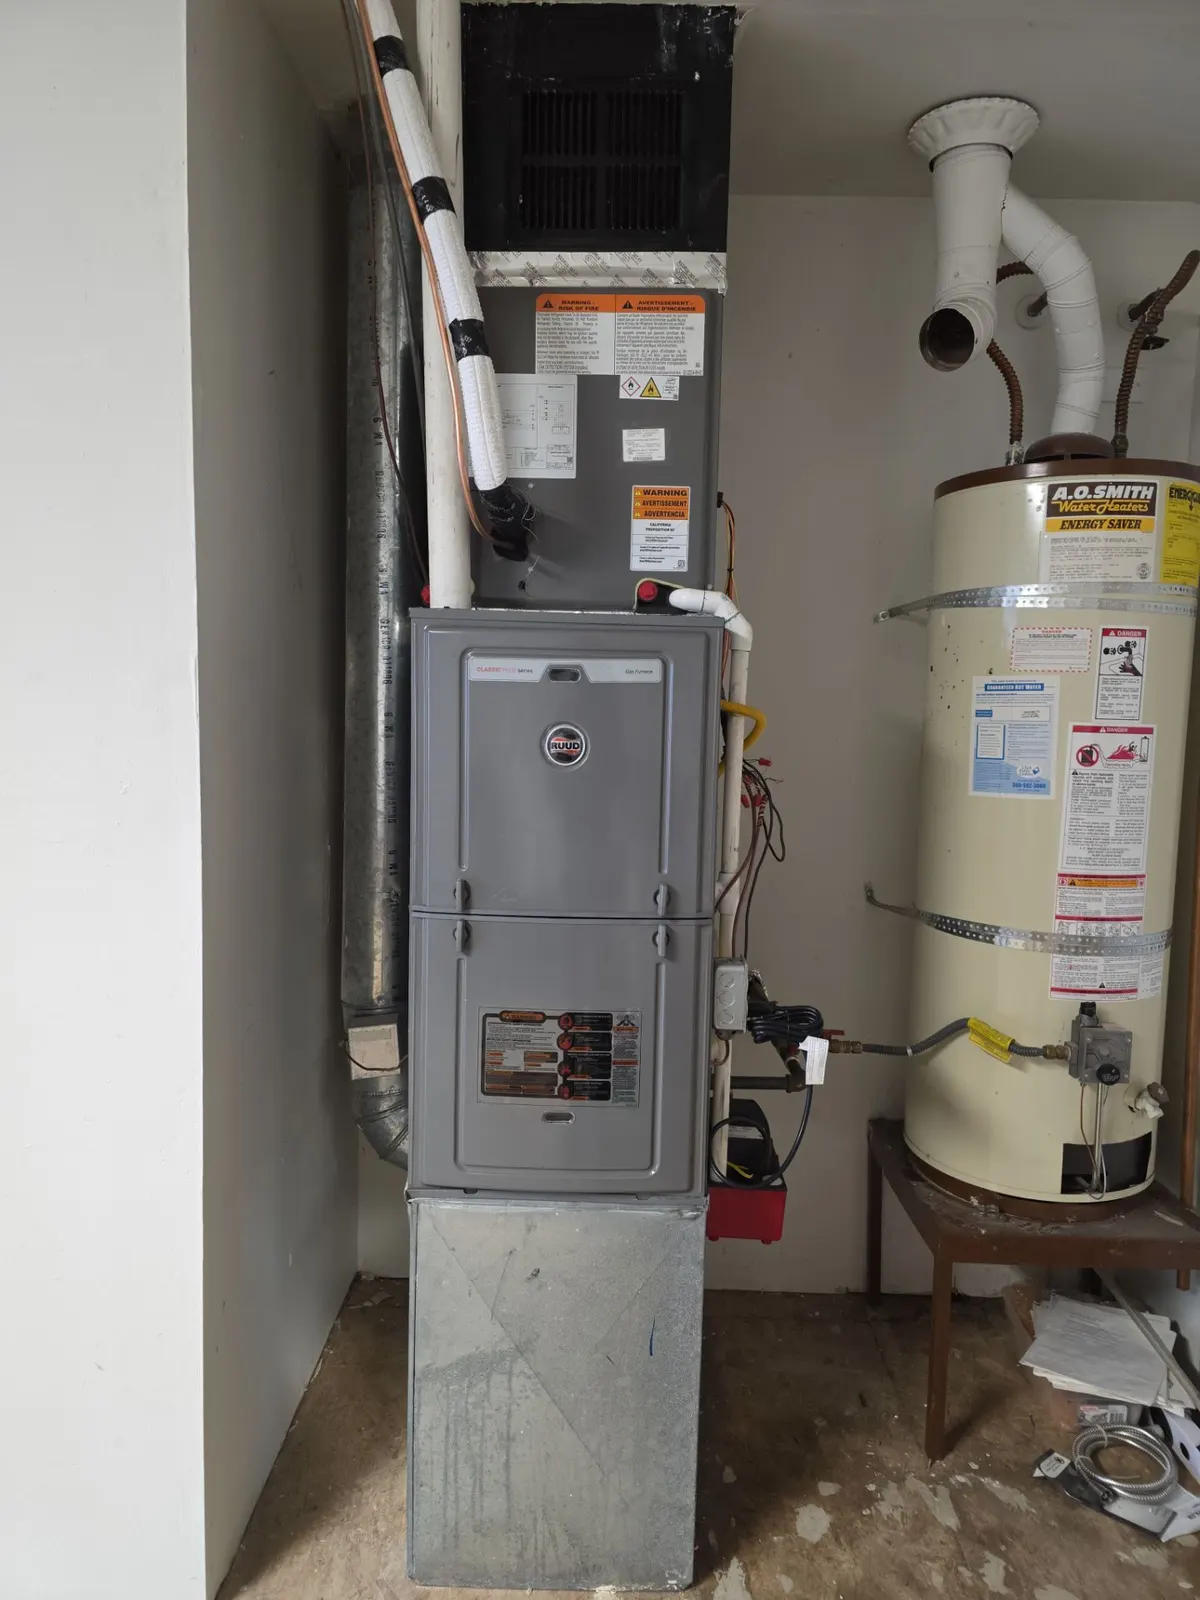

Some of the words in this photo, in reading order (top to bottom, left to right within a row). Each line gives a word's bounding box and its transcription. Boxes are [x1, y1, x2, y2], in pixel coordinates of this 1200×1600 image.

[642, 489, 687, 497] WARNING
[1055, 499, 1096, 513] Water
[1096, 499, 1149, 515] Heaters
[643, 510, 685, 518] ADVERTENCIA
[1060, 519, 1106, 530] ENERGY
[1107, 519, 1142, 530] SAVER
[551, 741, 580, 750] RUUD
